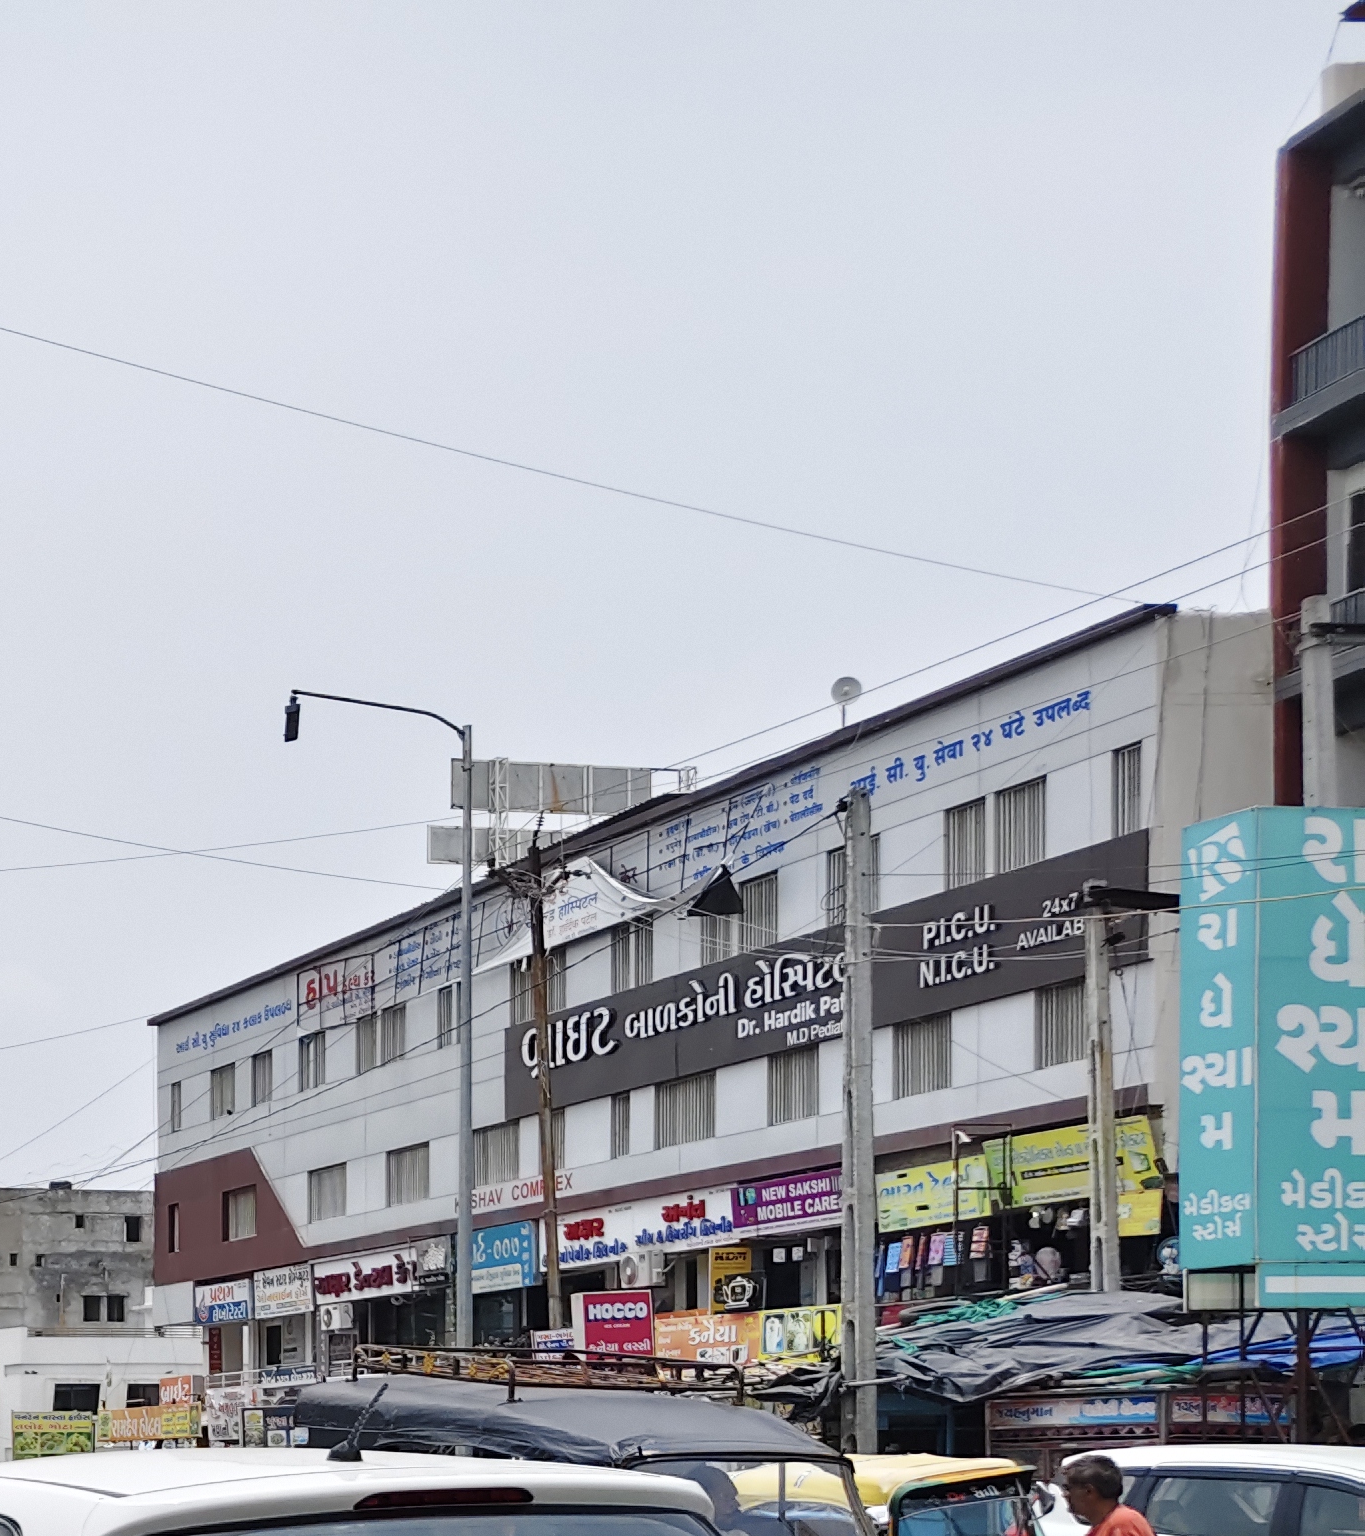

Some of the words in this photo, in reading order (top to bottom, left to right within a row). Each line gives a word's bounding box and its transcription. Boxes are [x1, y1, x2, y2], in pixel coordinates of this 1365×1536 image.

[933, 740, 964, 766] सेवा
[971, 730, 993, 751] २४
[1000, 711, 1026, 739] घंटे
[1042, 893, 1079, 918] 24x7
[922, 903, 997, 950] P.I.C.U.
[1016, 918, 1085, 951] AVAILAB
[919, 944, 996, 989] N.I.C.U.
[736, 1016, 760, 1040] Dr.
[763, 1000, 815, 1032] Hardik
[819, 996, 844, 1018] Pat
[511, 1172, 574, 1201] COMPEX
[761, 1184, 787, 1203] NEW
[788, 1177, 831, 1198] SAKSHI
[756, 1201, 804, 1222] MOBILE
[804, 1194, 840, 1214] CARE
[1183, 1188, 1251, 1218] મેડીકલ
[210, 1285, 235, 1304] પ્રથમ
[587, 1301, 649, 1321] HOCCO
[623, 1338, 651, 1352] લસ્સી
[688, 1319, 738, 1346] કનૈયા
